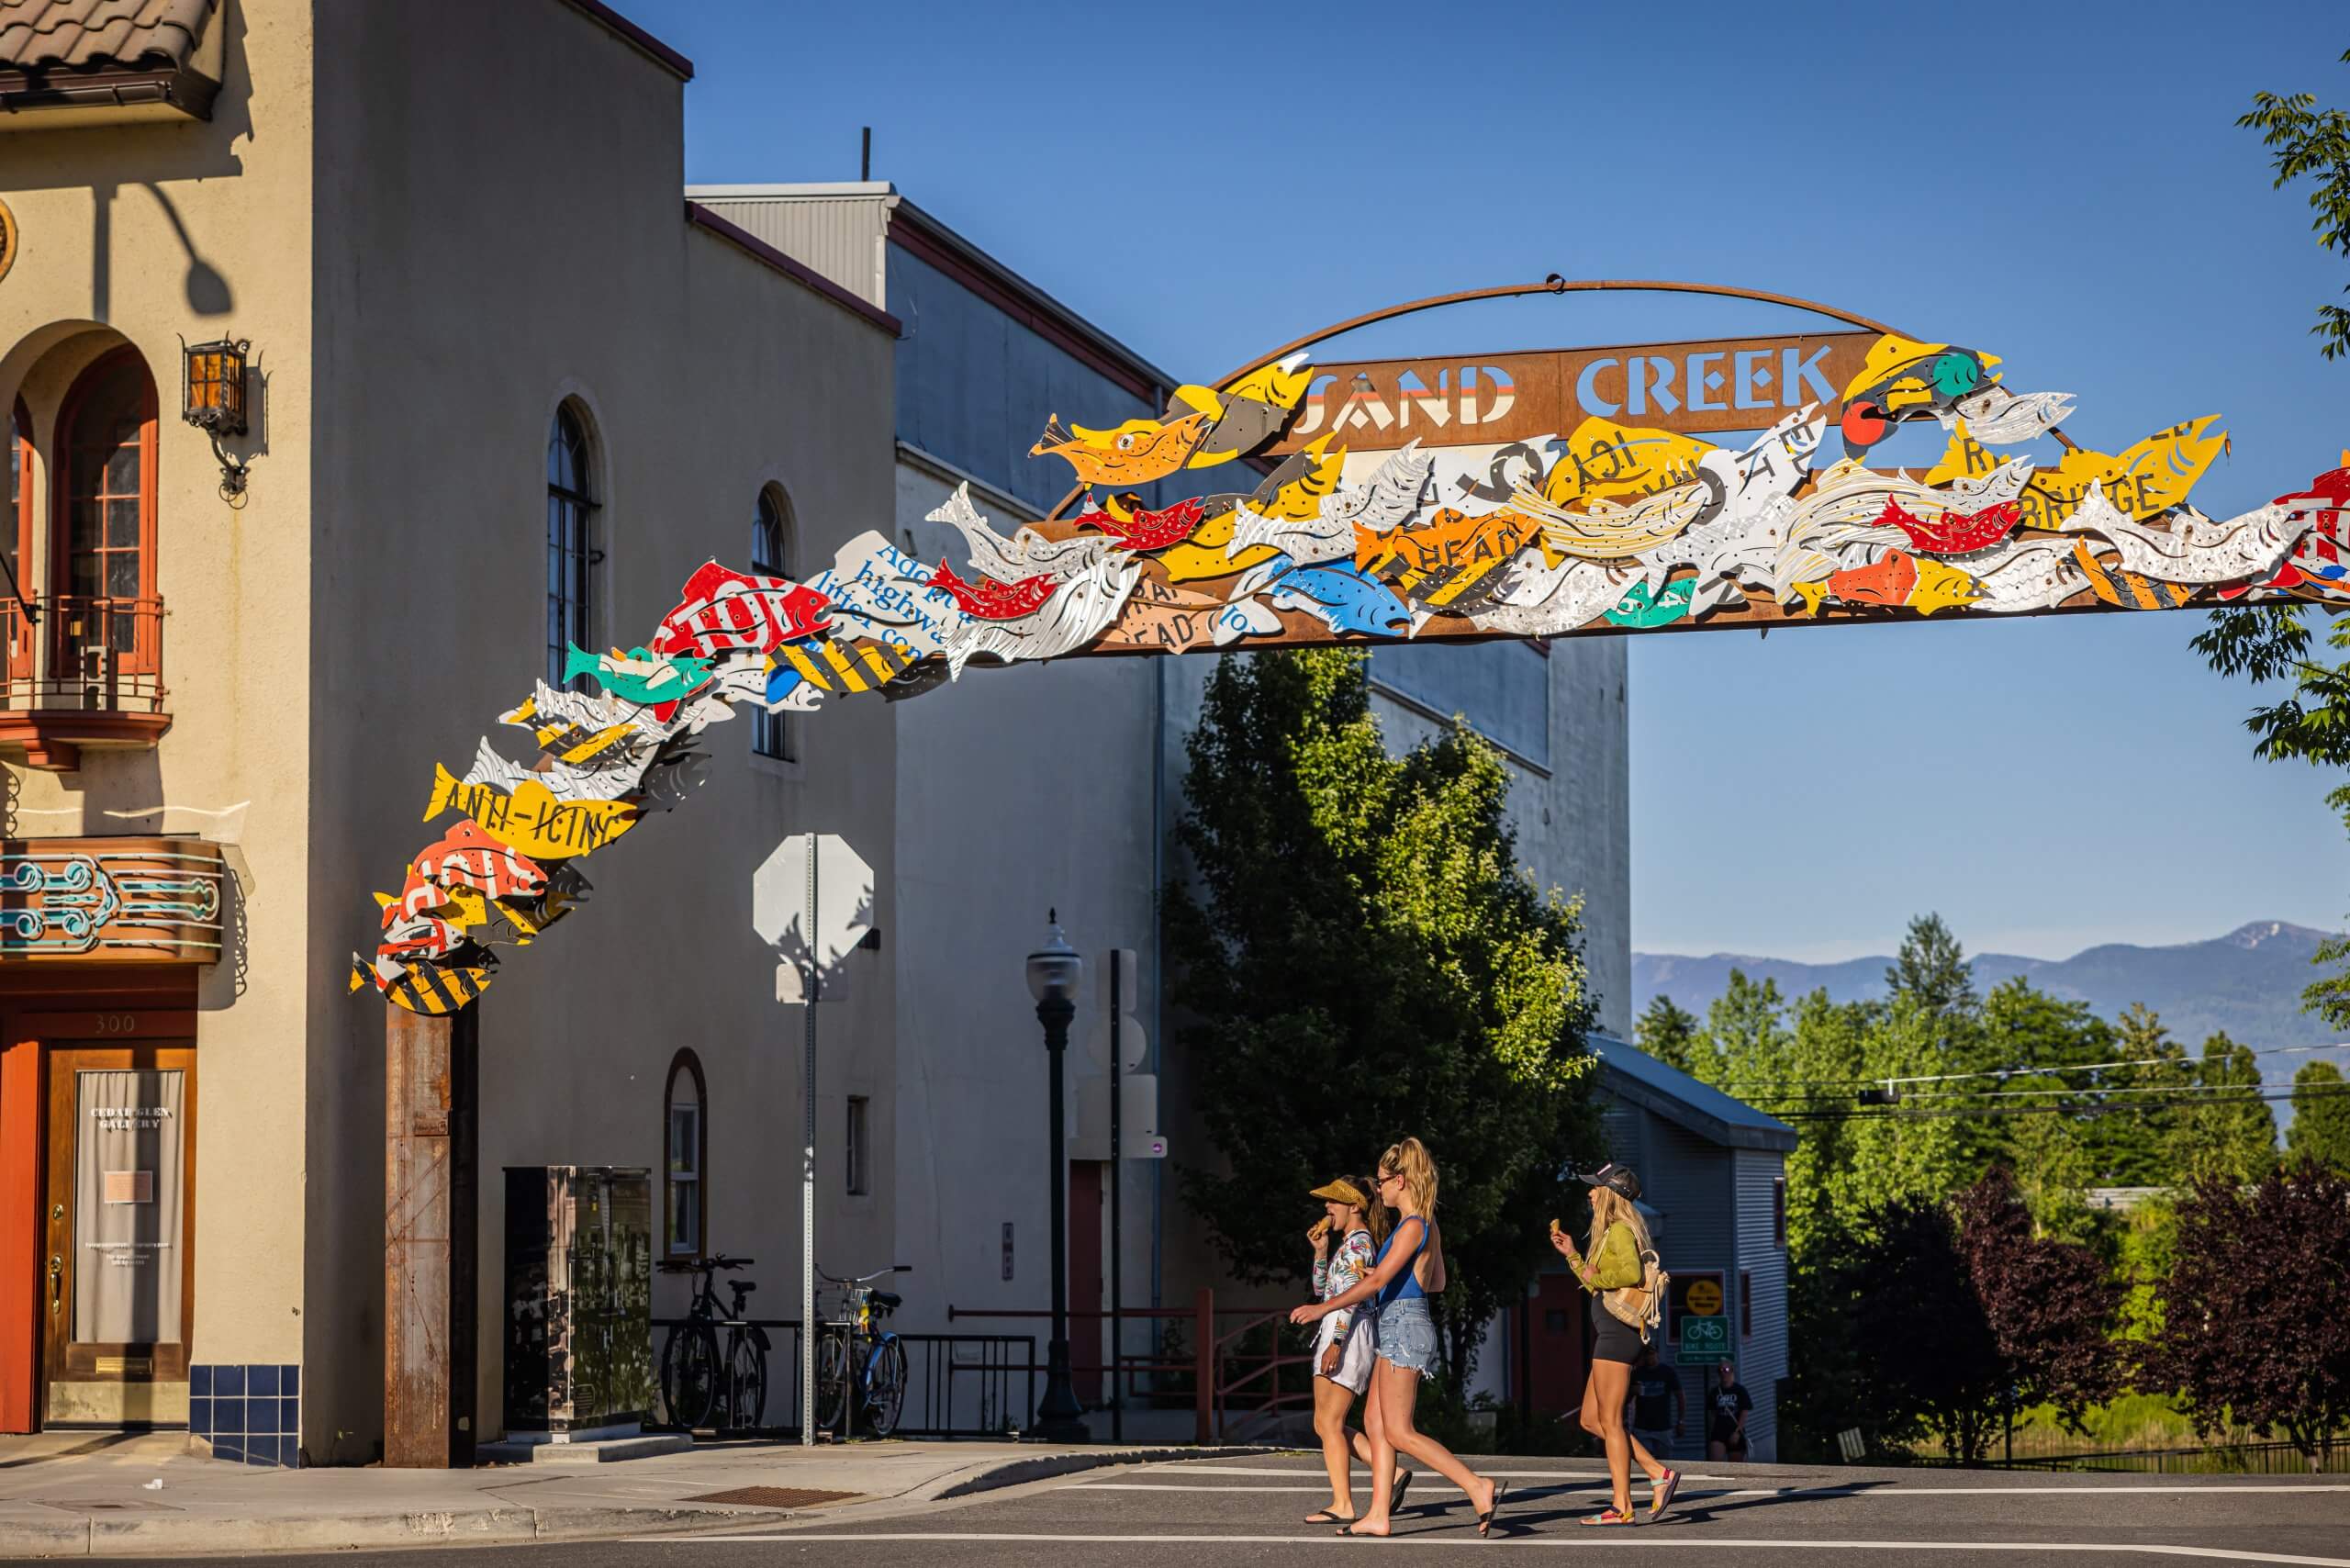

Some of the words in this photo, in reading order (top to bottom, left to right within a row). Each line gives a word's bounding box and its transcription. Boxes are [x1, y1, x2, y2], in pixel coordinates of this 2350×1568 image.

[1294, 364, 1515, 435] SAND
[1576, 344, 1839, 418] CREEK
[2020, 473, 2160, 529] BRIGE
[95, 1015, 135, 1035] 300
